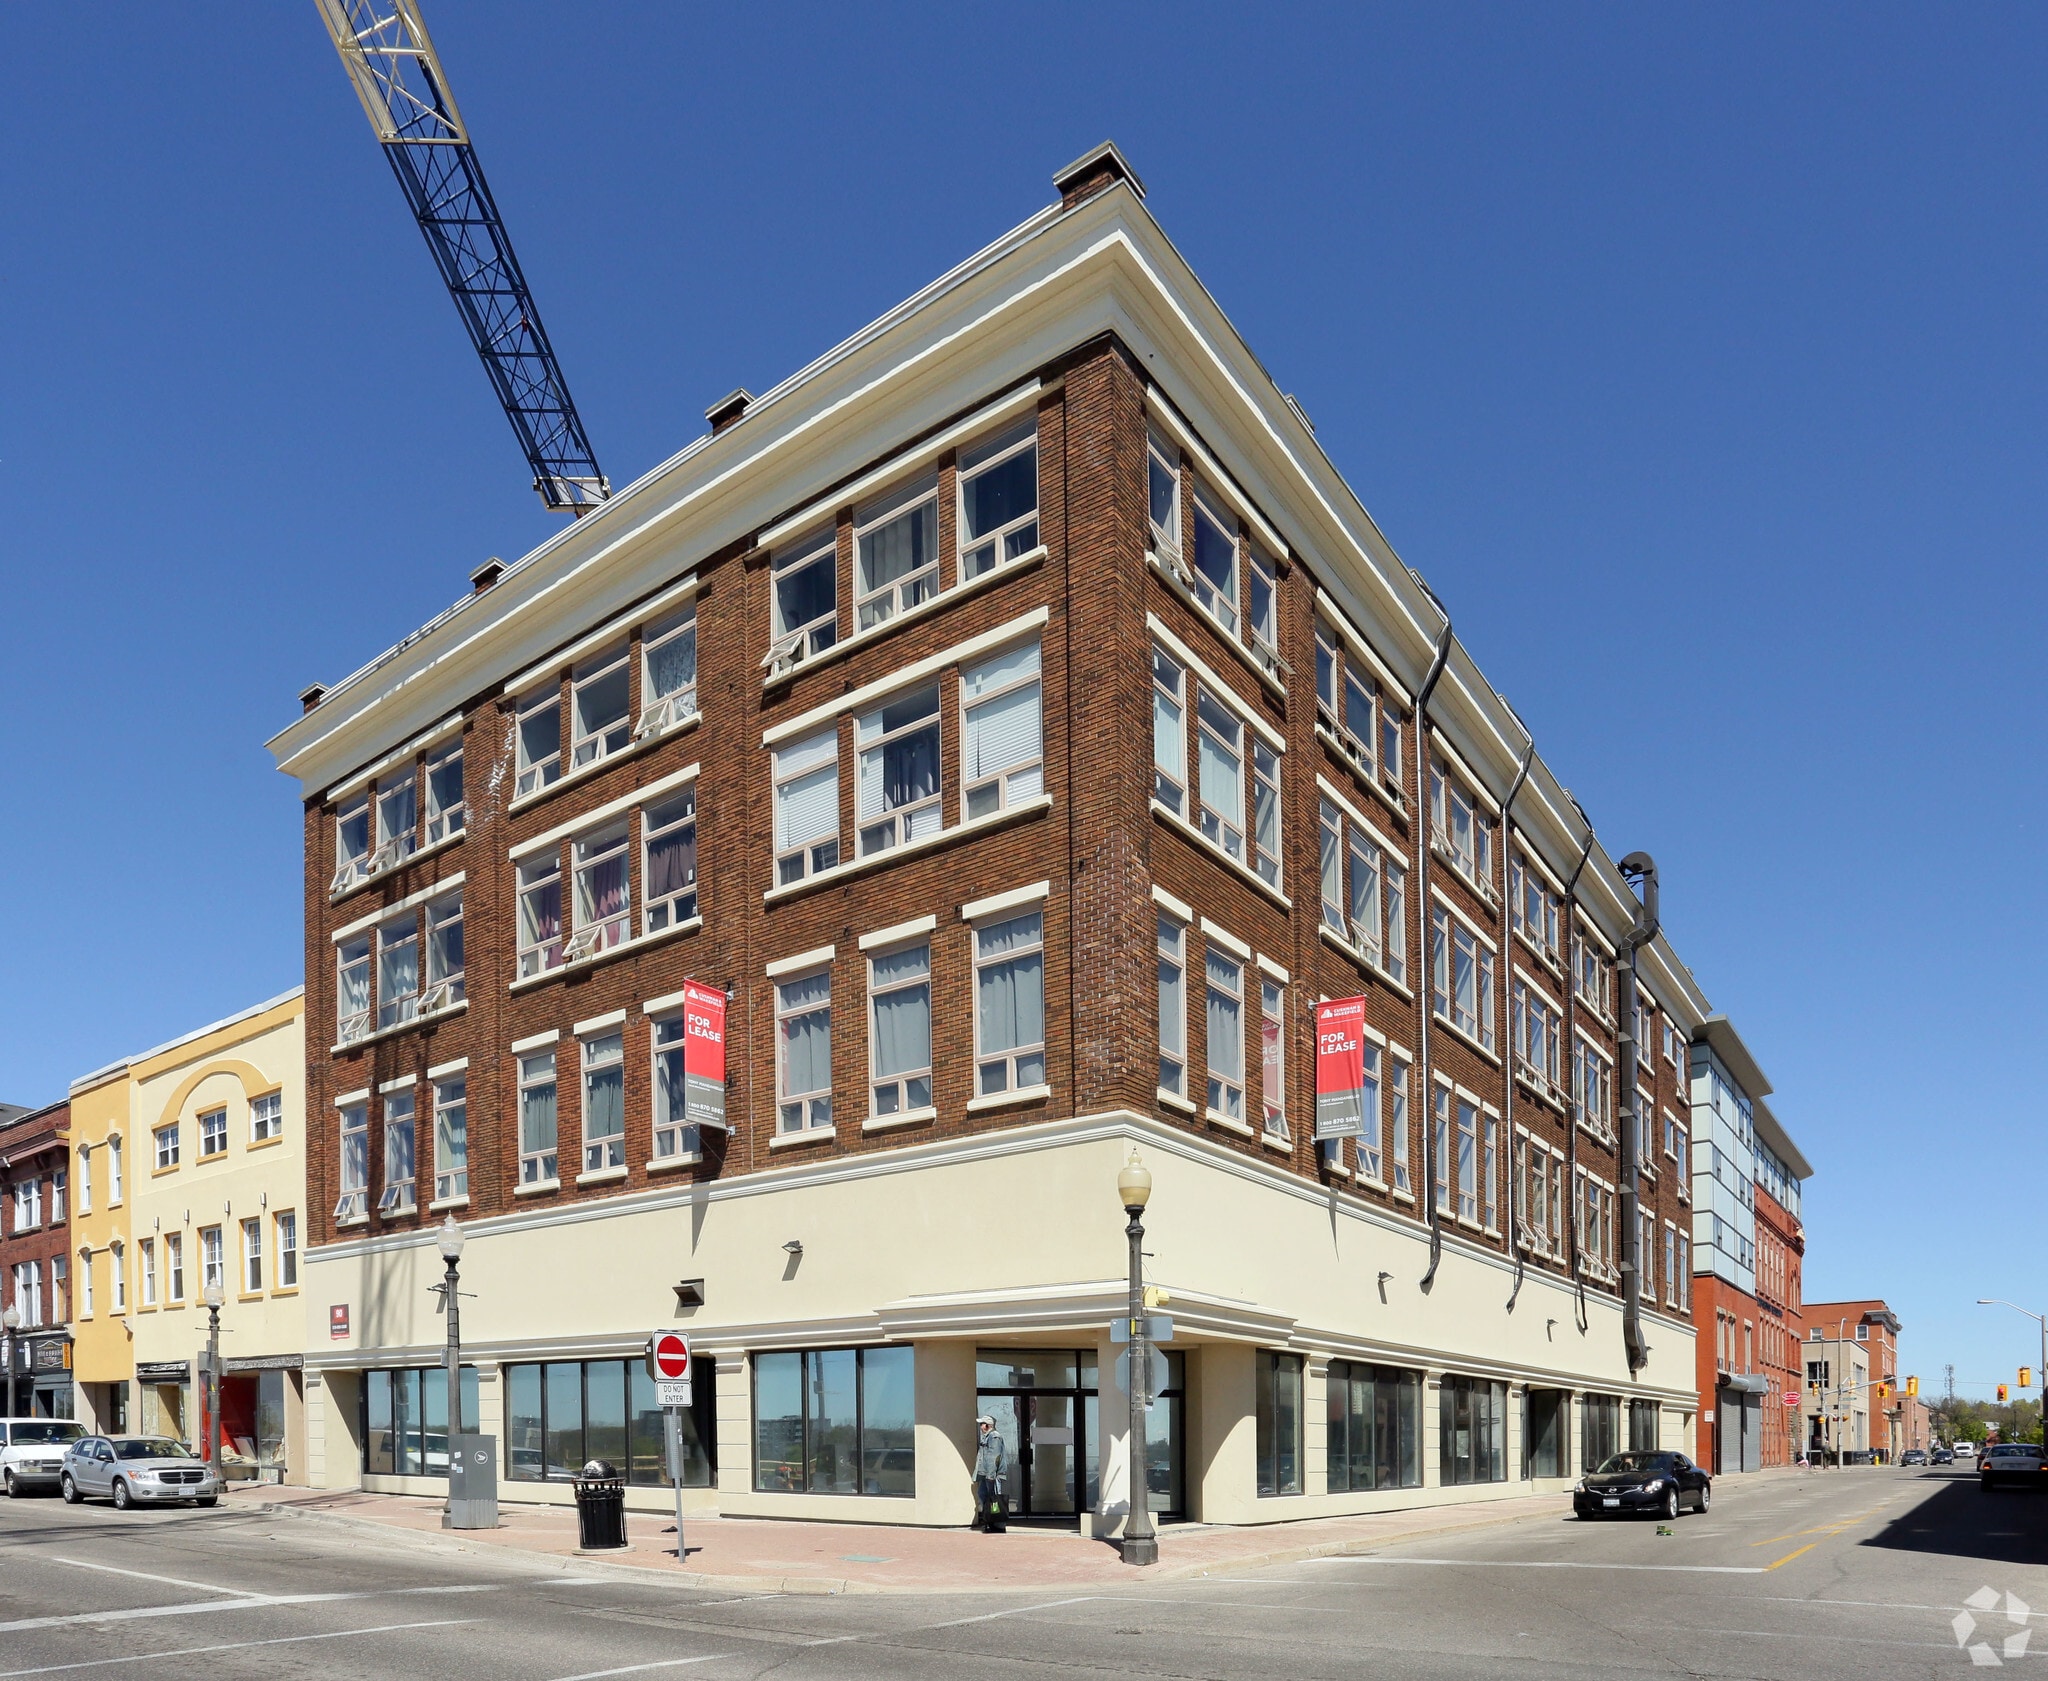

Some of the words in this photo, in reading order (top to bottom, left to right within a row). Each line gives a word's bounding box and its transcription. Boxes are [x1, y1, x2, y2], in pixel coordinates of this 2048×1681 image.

[688, 1013, 711, 1029] FOR
[688, 1024, 722, 1043] LEASE
[1320, 1031, 1345, 1045] FOR
[1320, 1040, 1357, 1055] LEASE
[673, 1385, 684, 1393] NOT
[665, 1395, 684, 1403] ENTER
